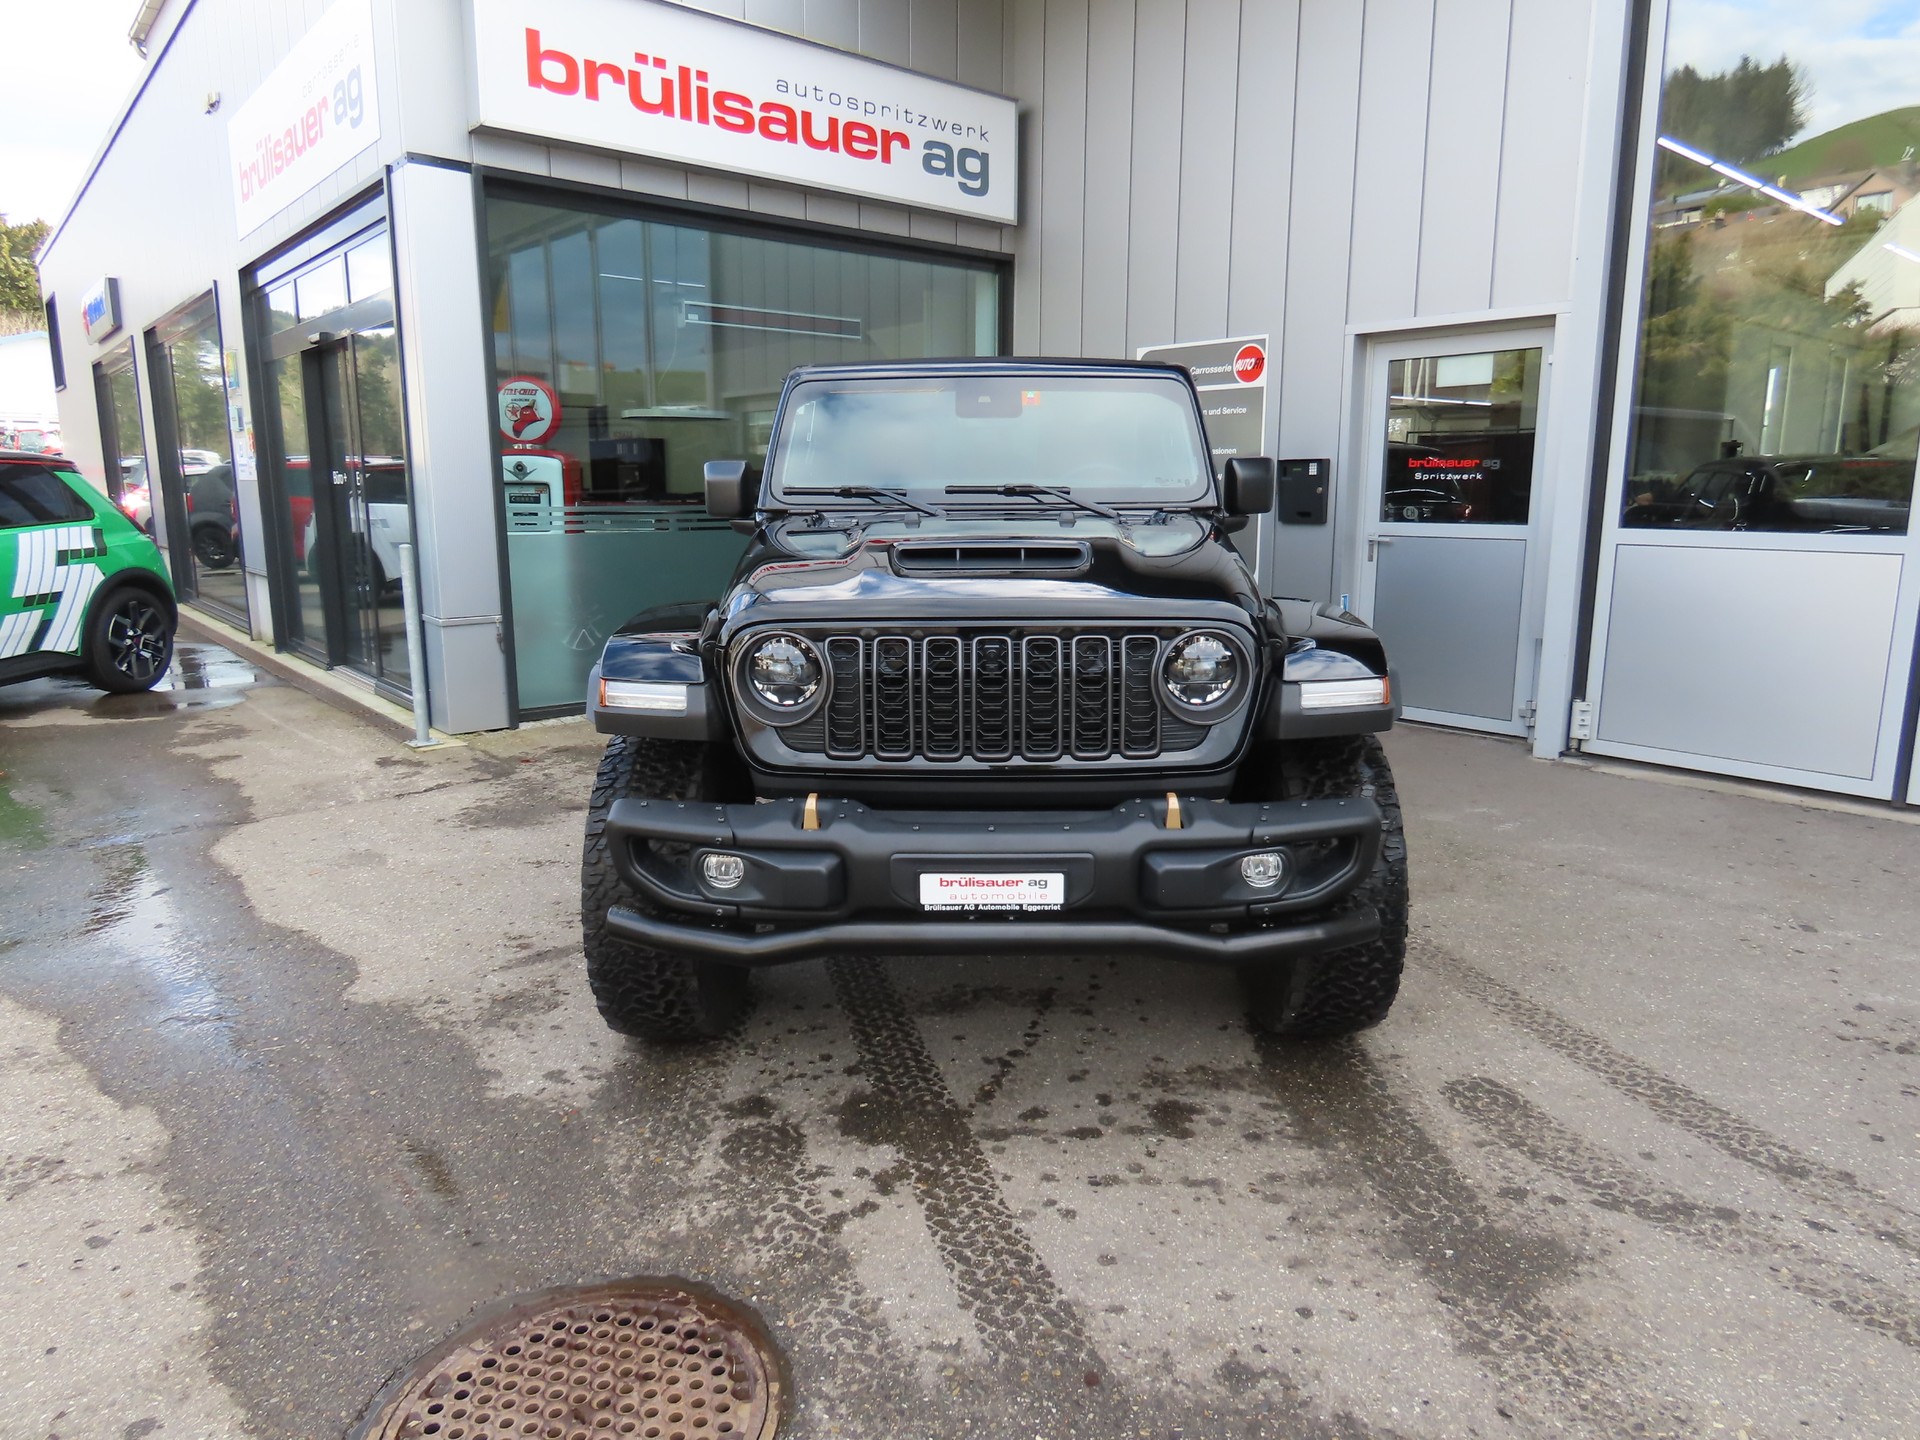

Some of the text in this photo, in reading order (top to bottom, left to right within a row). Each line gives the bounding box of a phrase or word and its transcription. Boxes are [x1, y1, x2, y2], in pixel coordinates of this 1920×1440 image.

[302, 34, 359, 98] carrosserie
[525, 27, 990, 197] brülisauer ag
[776, 79, 989, 142] autospritzwerk
[239, 63, 364, 204] brülisauer ag
[1190, 363, 1232, 375] Carrosserie
[1208, 407, 1221, 416] und
[1222, 406, 1247, 415] Service
[1482, 459, 1501, 470] ag
[1414, 472, 1483, 481] Spritzwerk
[939, 877, 1048, 889] brülisauer ag
[949, 892, 1048, 900] automobile
[924, 903, 962, 911] Brülisauer
[1022, 904, 1061, 912] Eggersriet
